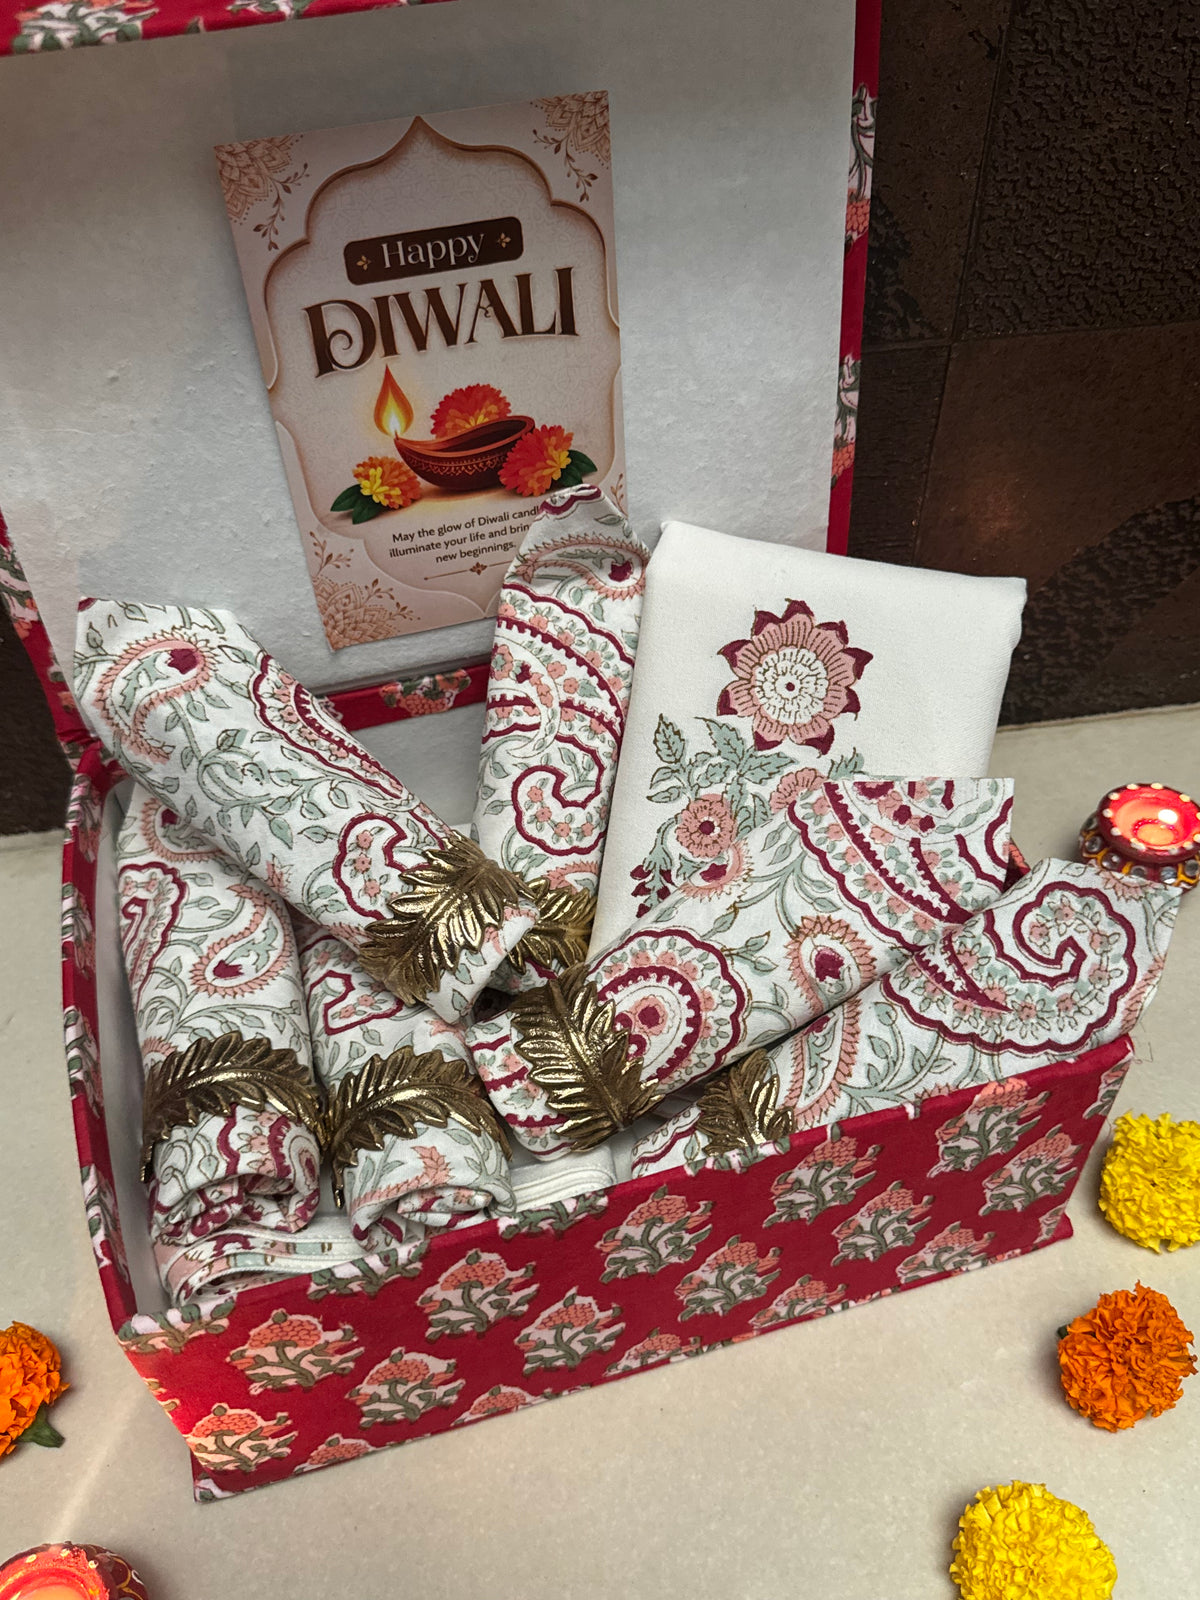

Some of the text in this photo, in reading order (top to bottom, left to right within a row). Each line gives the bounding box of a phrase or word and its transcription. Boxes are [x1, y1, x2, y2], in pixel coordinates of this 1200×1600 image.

[380, 233, 485, 270] Happy
[302, 266, 580, 379] DIWALI
[389, 523, 530, 558] illuminate your life and brin
[392, 505, 539, 543] May the glow of Diwali candl
[435, 541, 517, 563] new beginnings.
